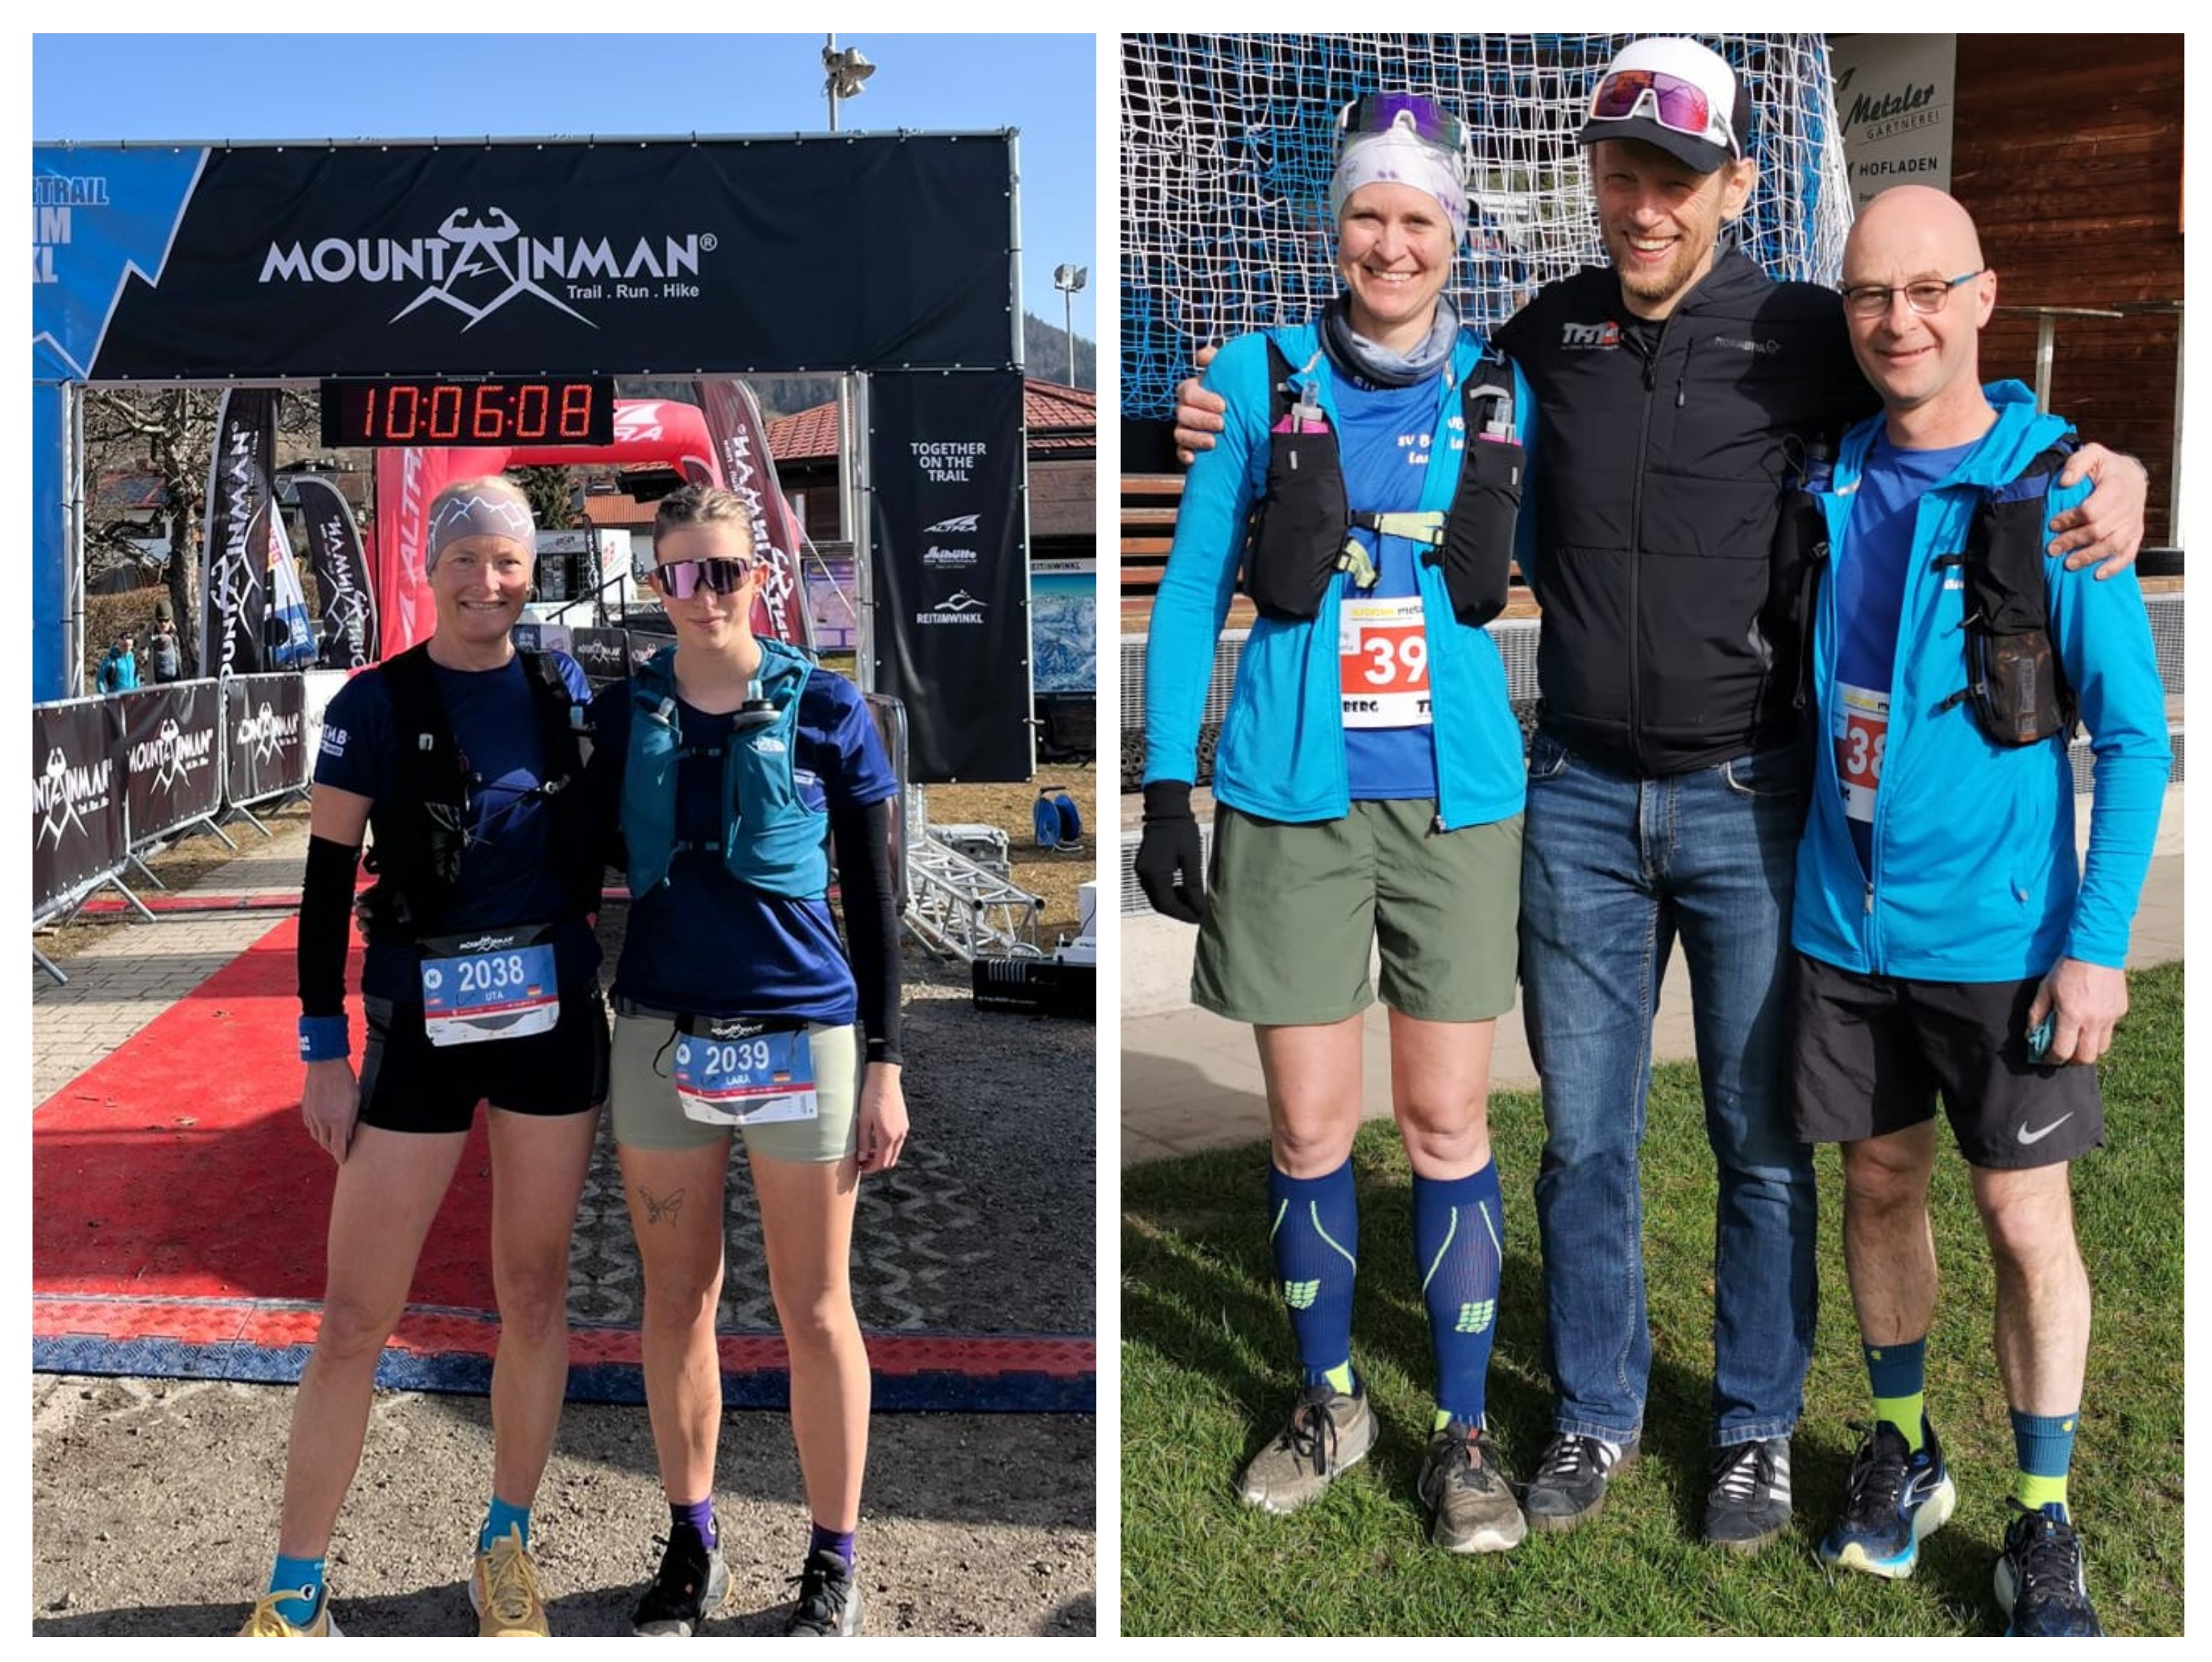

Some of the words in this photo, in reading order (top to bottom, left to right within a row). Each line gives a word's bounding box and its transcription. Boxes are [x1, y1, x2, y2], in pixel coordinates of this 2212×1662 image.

[1842, 83, 1934, 136] Metzler
[1859, 157, 1937, 176] HOFLADEN
[567, 285, 602, 299] Trail
[616, 283, 649, 298] Run
[663, 283, 699, 297] Hike
[365, 385, 591, 438] 10:06:08
[910, 442, 987, 455] TOGETHER
[919, 456, 942, 468] ON
[946, 456, 974, 468] THE
[928, 469, 969, 481] TRAIL
[399, 449, 422, 580] ALTR
[1363, 635, 1428, 686] 39
[458, 954, 525, 992] 2038
[485, 992, 504, 1001] UTA
[705, 1040, 769, 1075] 2039
